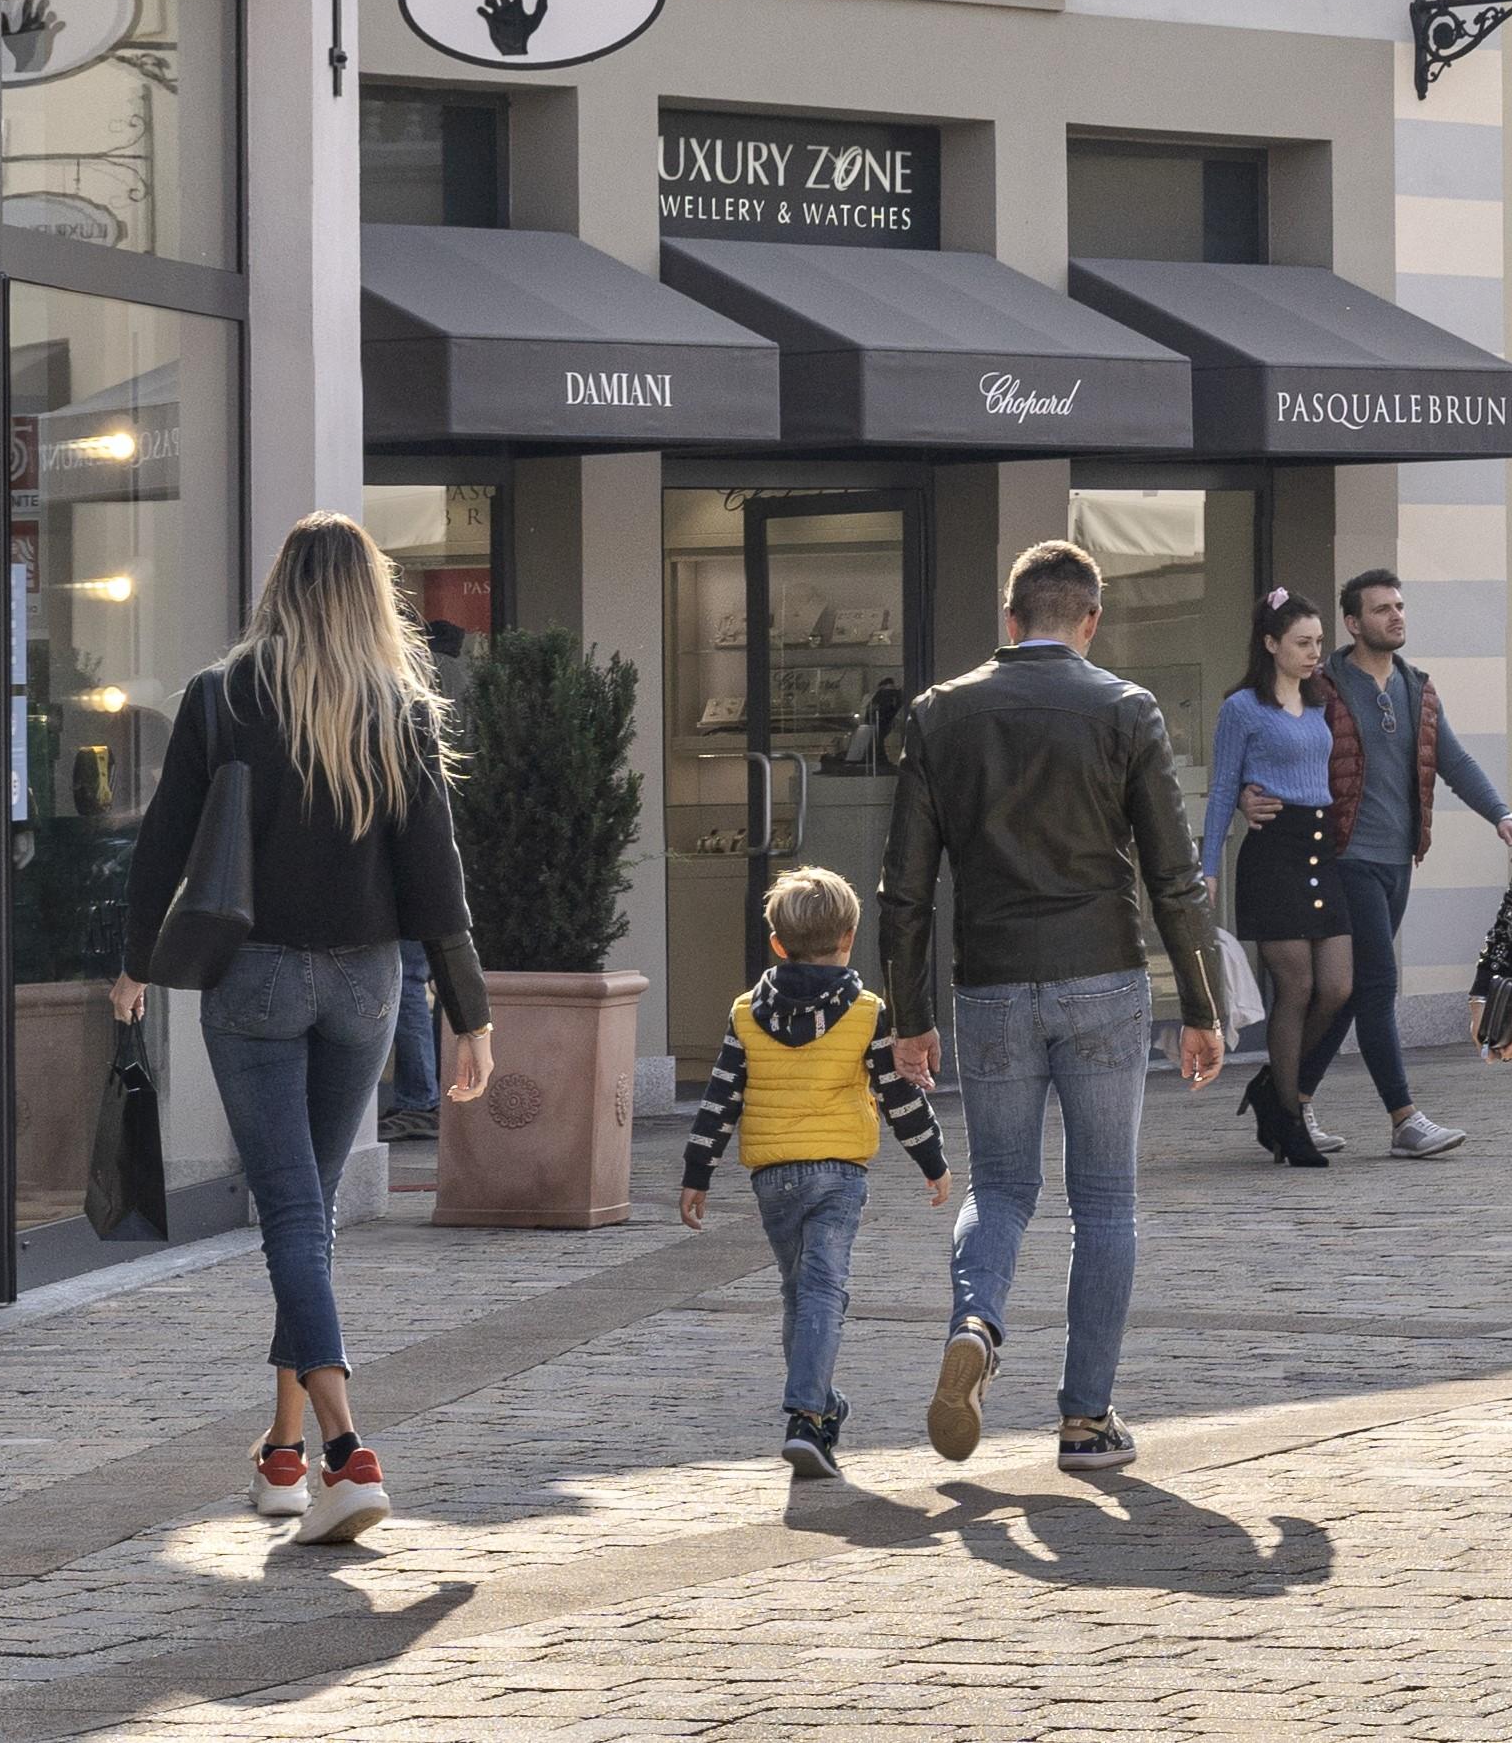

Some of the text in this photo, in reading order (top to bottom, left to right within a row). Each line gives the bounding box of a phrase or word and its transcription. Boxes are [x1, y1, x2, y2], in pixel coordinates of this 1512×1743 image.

[657, 135, 914, 194] UXURY ZONE
[659, 194, 912, 230] WELLERY & WATCHES
[565, 371, 673, 408] DAMIANI
[979, 371, 1081, 424] Chopard
